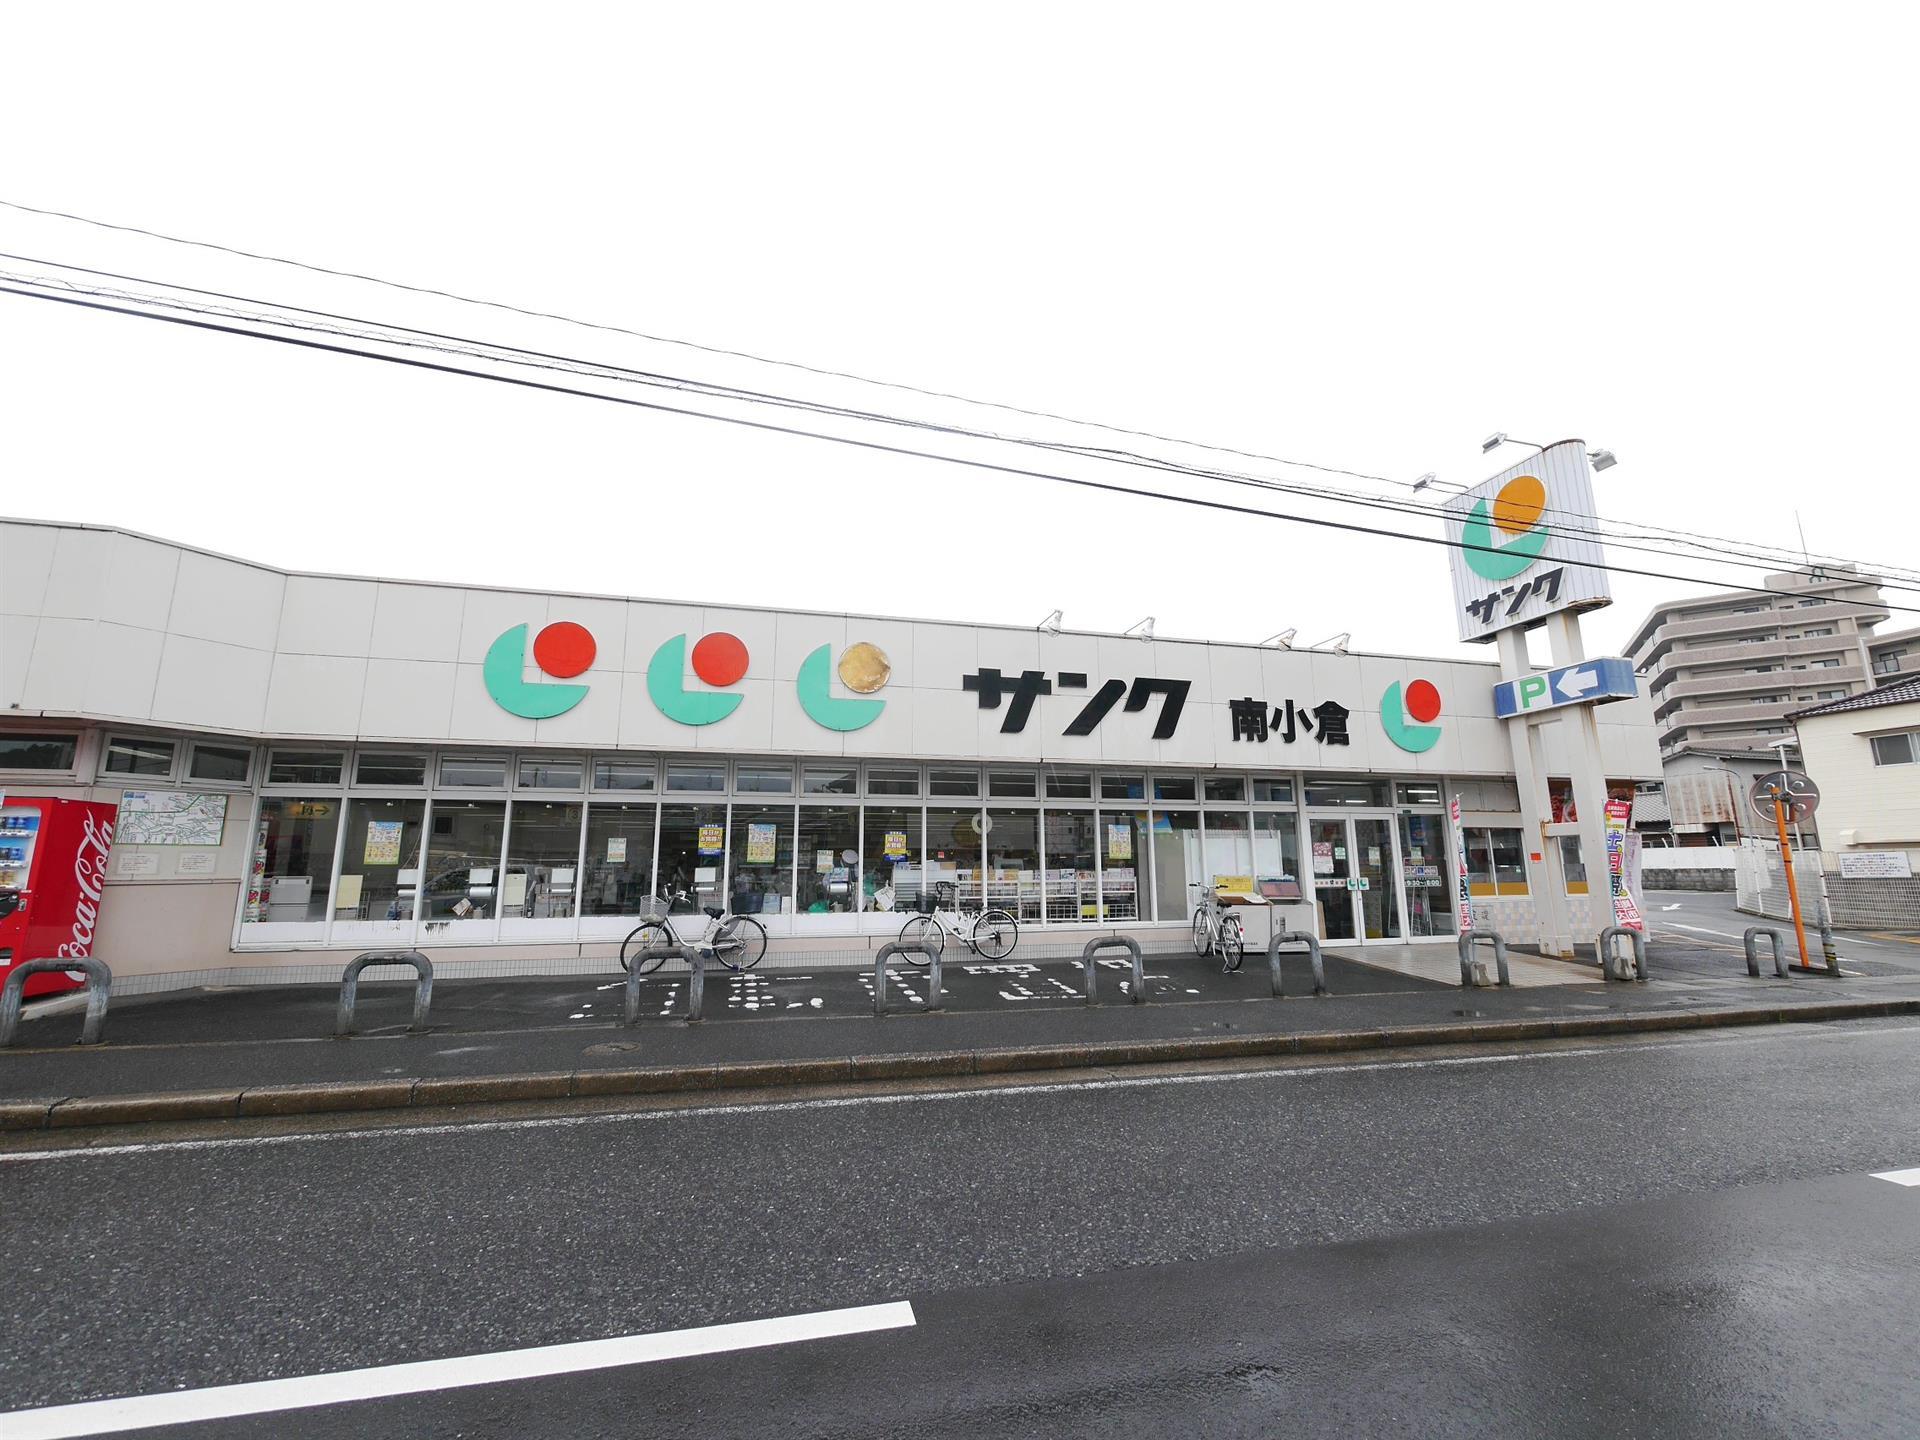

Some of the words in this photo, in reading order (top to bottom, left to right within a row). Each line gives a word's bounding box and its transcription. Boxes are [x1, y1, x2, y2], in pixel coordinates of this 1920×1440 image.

[1465, 567, 1565, 624] サンク
[962, 667, 1192, 739] サンク
[1229, 697, 1350, 746] 南小倉
[1520, 677, 1547, 708] P
